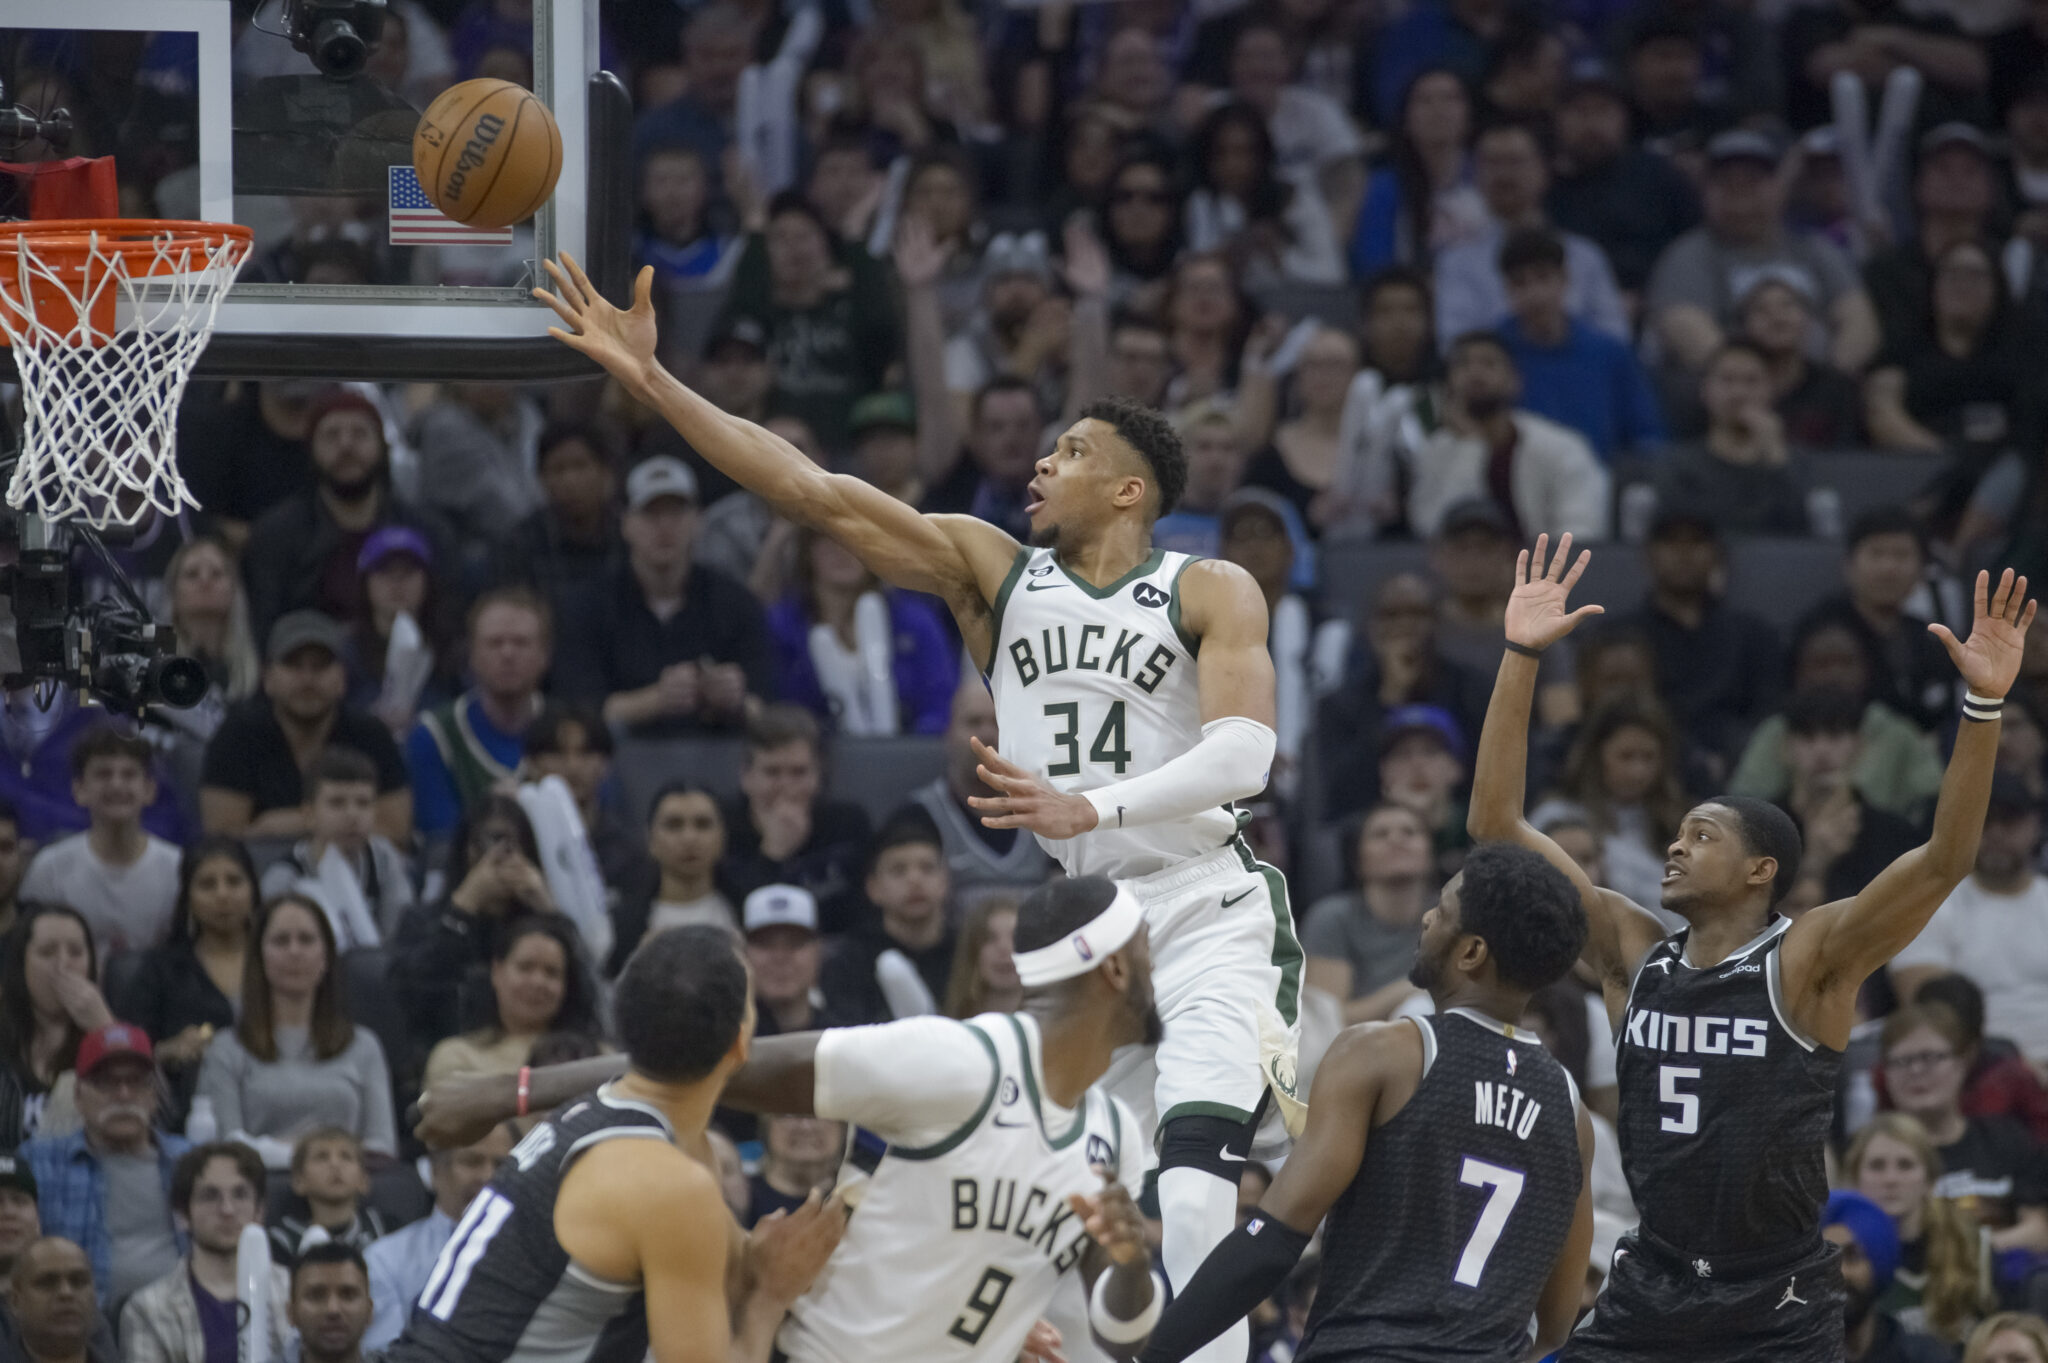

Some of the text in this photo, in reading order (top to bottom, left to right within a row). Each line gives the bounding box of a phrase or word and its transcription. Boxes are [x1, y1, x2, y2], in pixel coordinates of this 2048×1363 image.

[444, 113, 505, 203] Wilson
[1008, 624, 1177, 695] BUCKS
[1043, 700, 1132, 777] 34
[1624, 1007, 1769, 1058] KINGS
[1475, 1080, 1542, 1141] METU
[1659, 1065, 1701, 1135] 5
[952, 1178, 1091, 1276] BUCKS
[1454, 1154, 1527, 1289] 7
[947, 1266, 1015, 1347] 9
